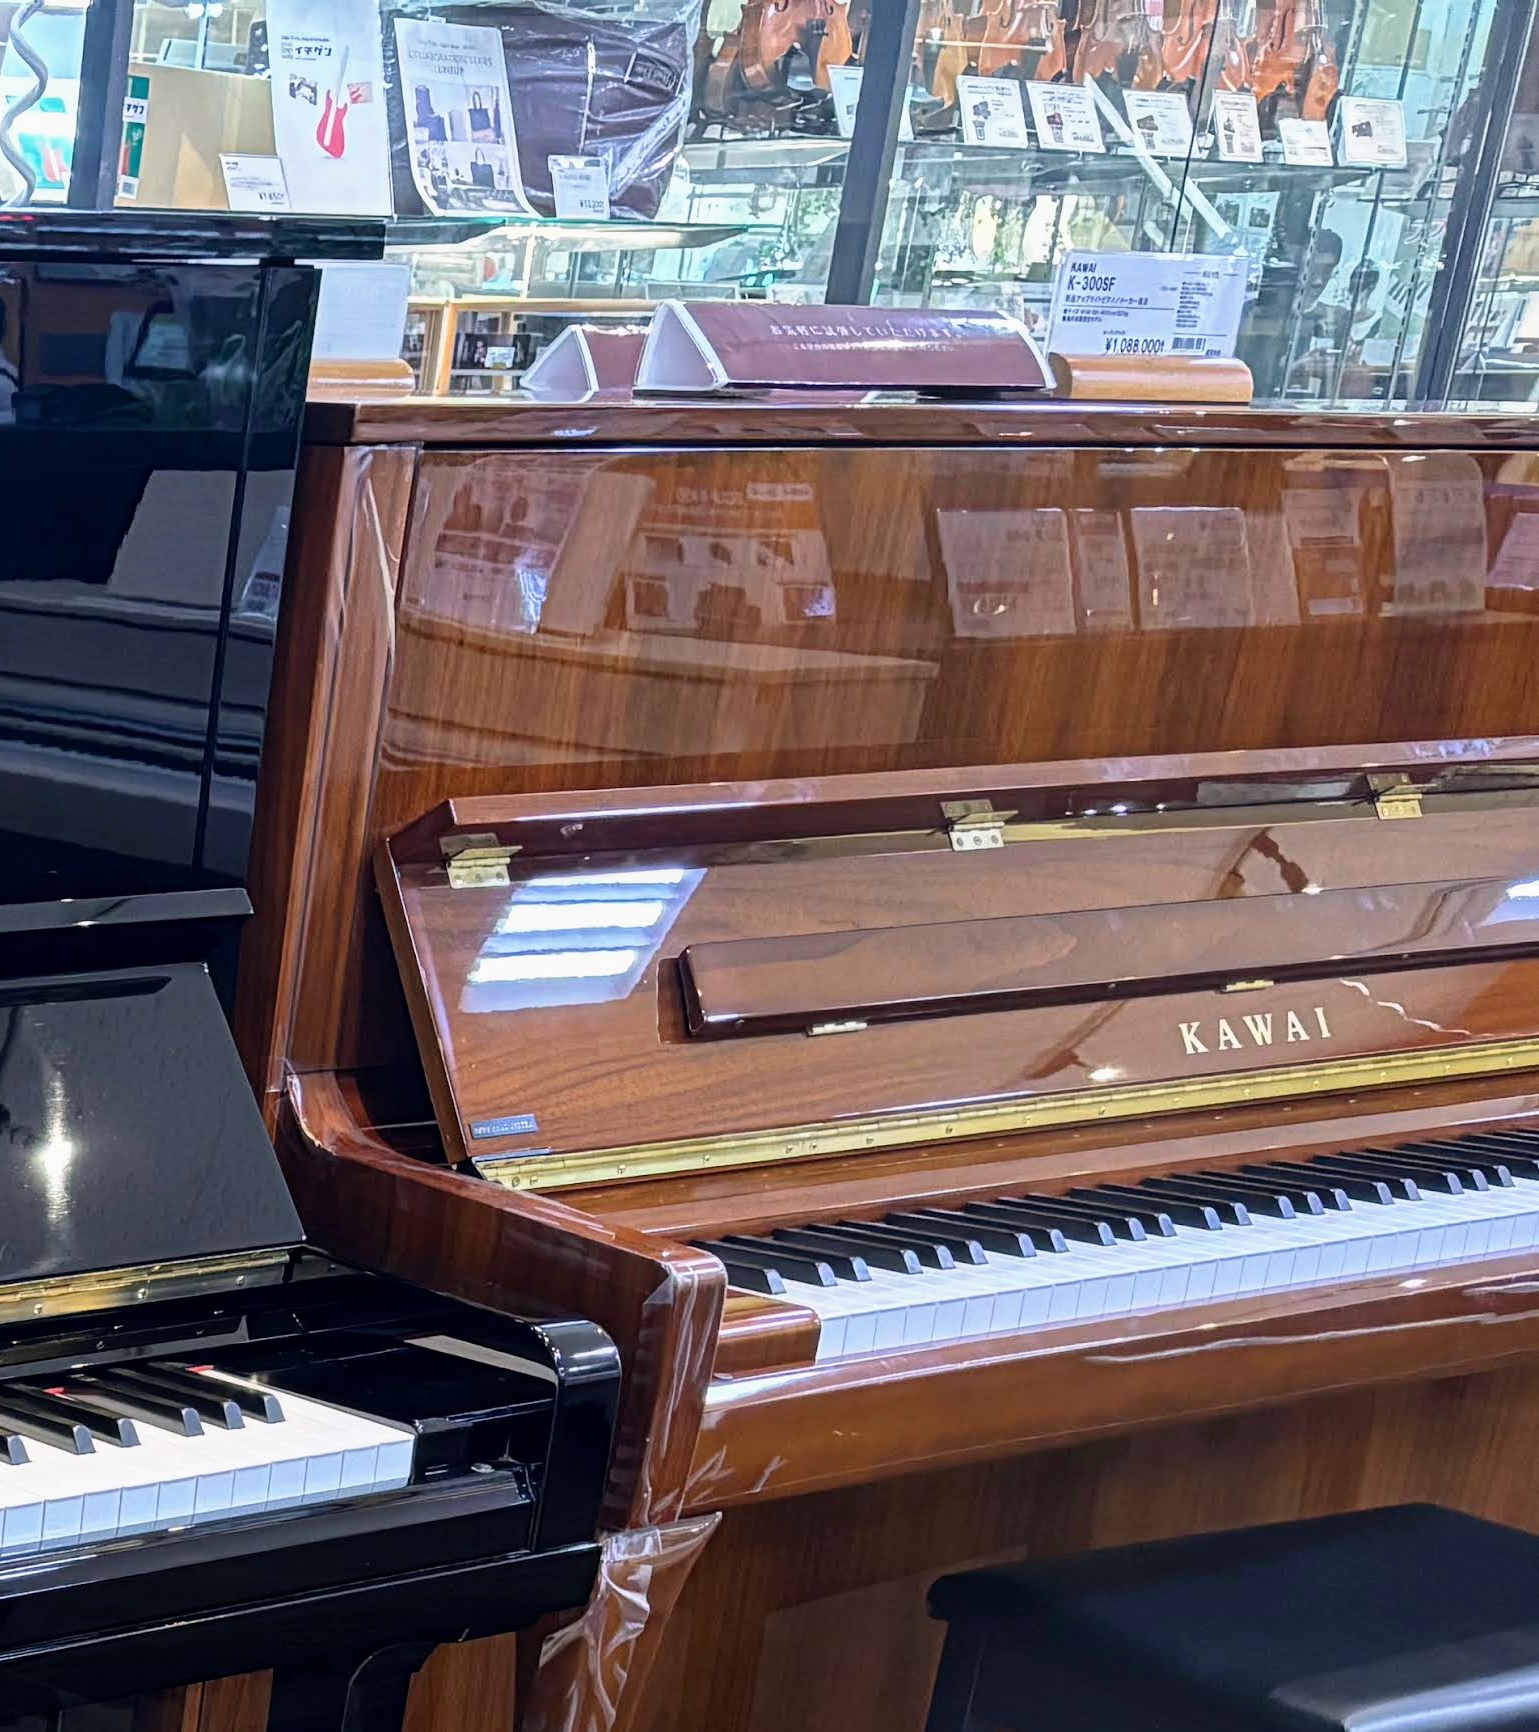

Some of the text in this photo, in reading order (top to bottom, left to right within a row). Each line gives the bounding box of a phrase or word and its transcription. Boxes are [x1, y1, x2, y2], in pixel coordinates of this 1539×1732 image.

[1071, 262, 1097, 273] KAWAI
[1067, 275, 1117, 292] K-300SF
[1178, 1007, 1331, 1054] KAWAI
